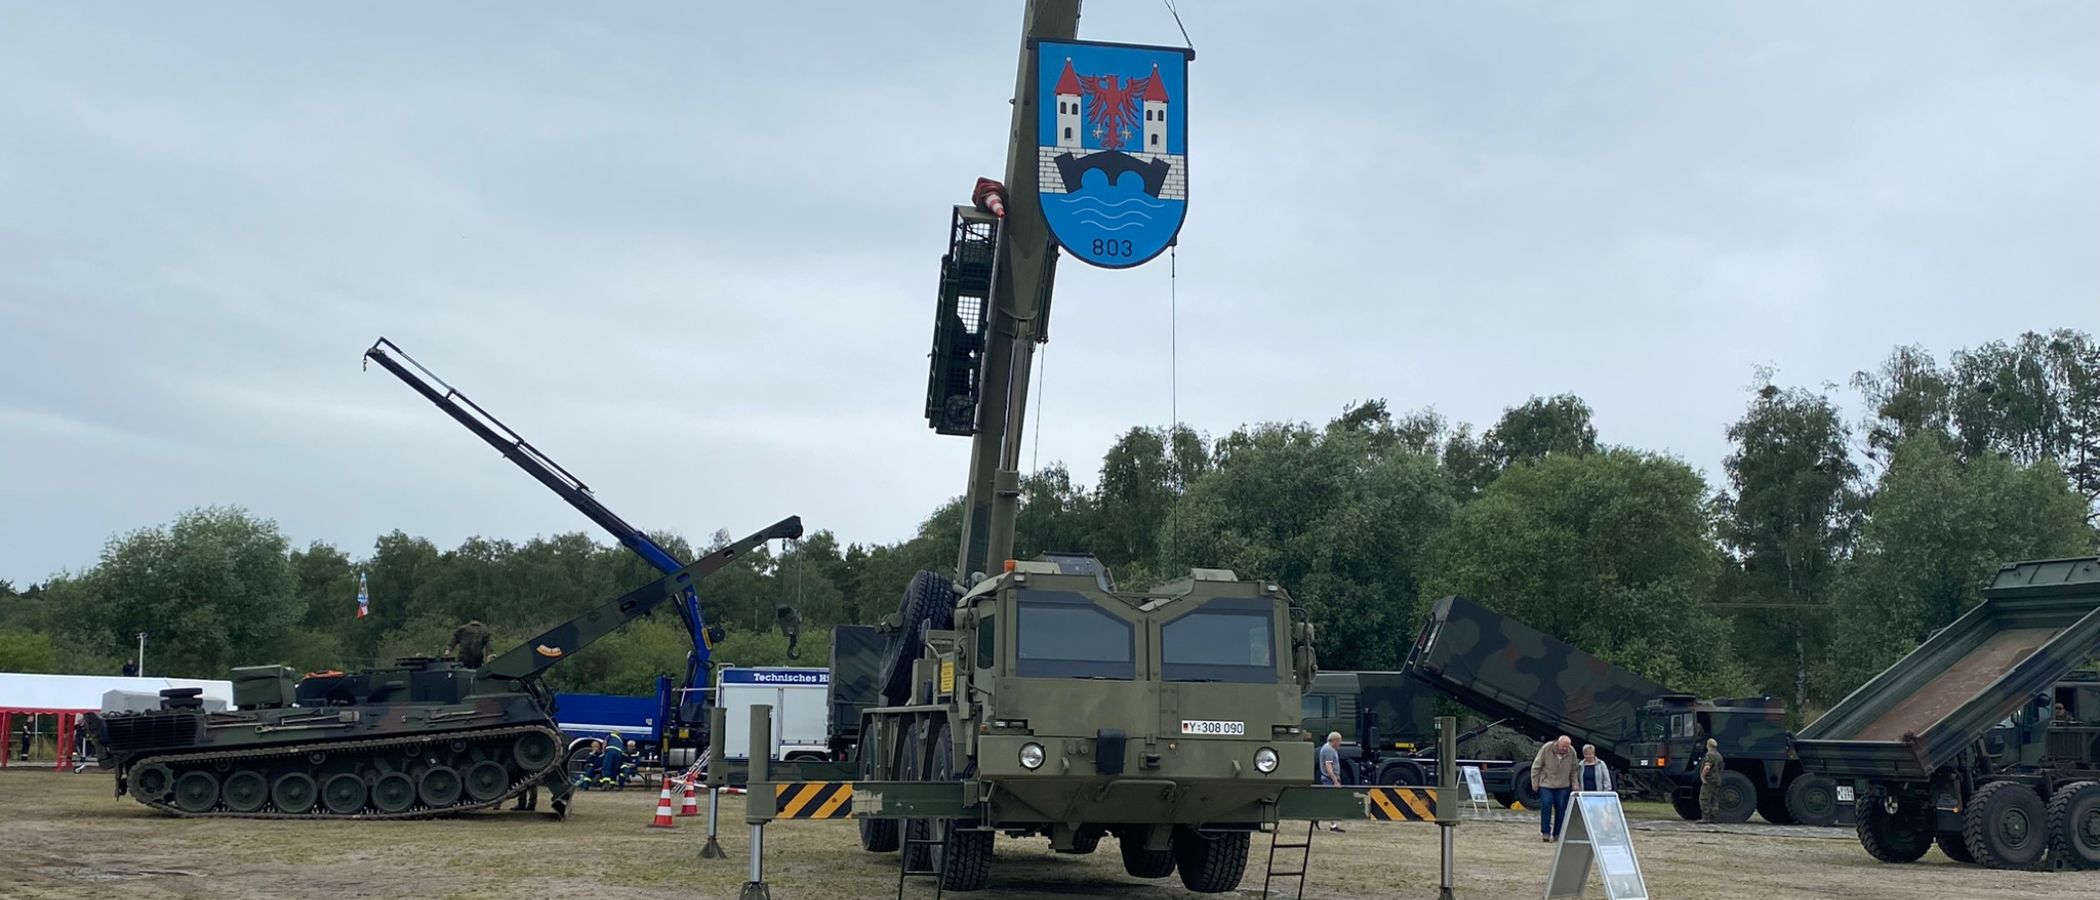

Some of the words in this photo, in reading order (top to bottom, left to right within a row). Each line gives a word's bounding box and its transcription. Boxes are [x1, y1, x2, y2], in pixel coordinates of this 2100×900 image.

[1092, 238, 1133, 257] 803
[753, 673, 817, 682] Technisches
[1202, 722, 1221, 733] 308
[1223, 723, 1243, 734] 090
